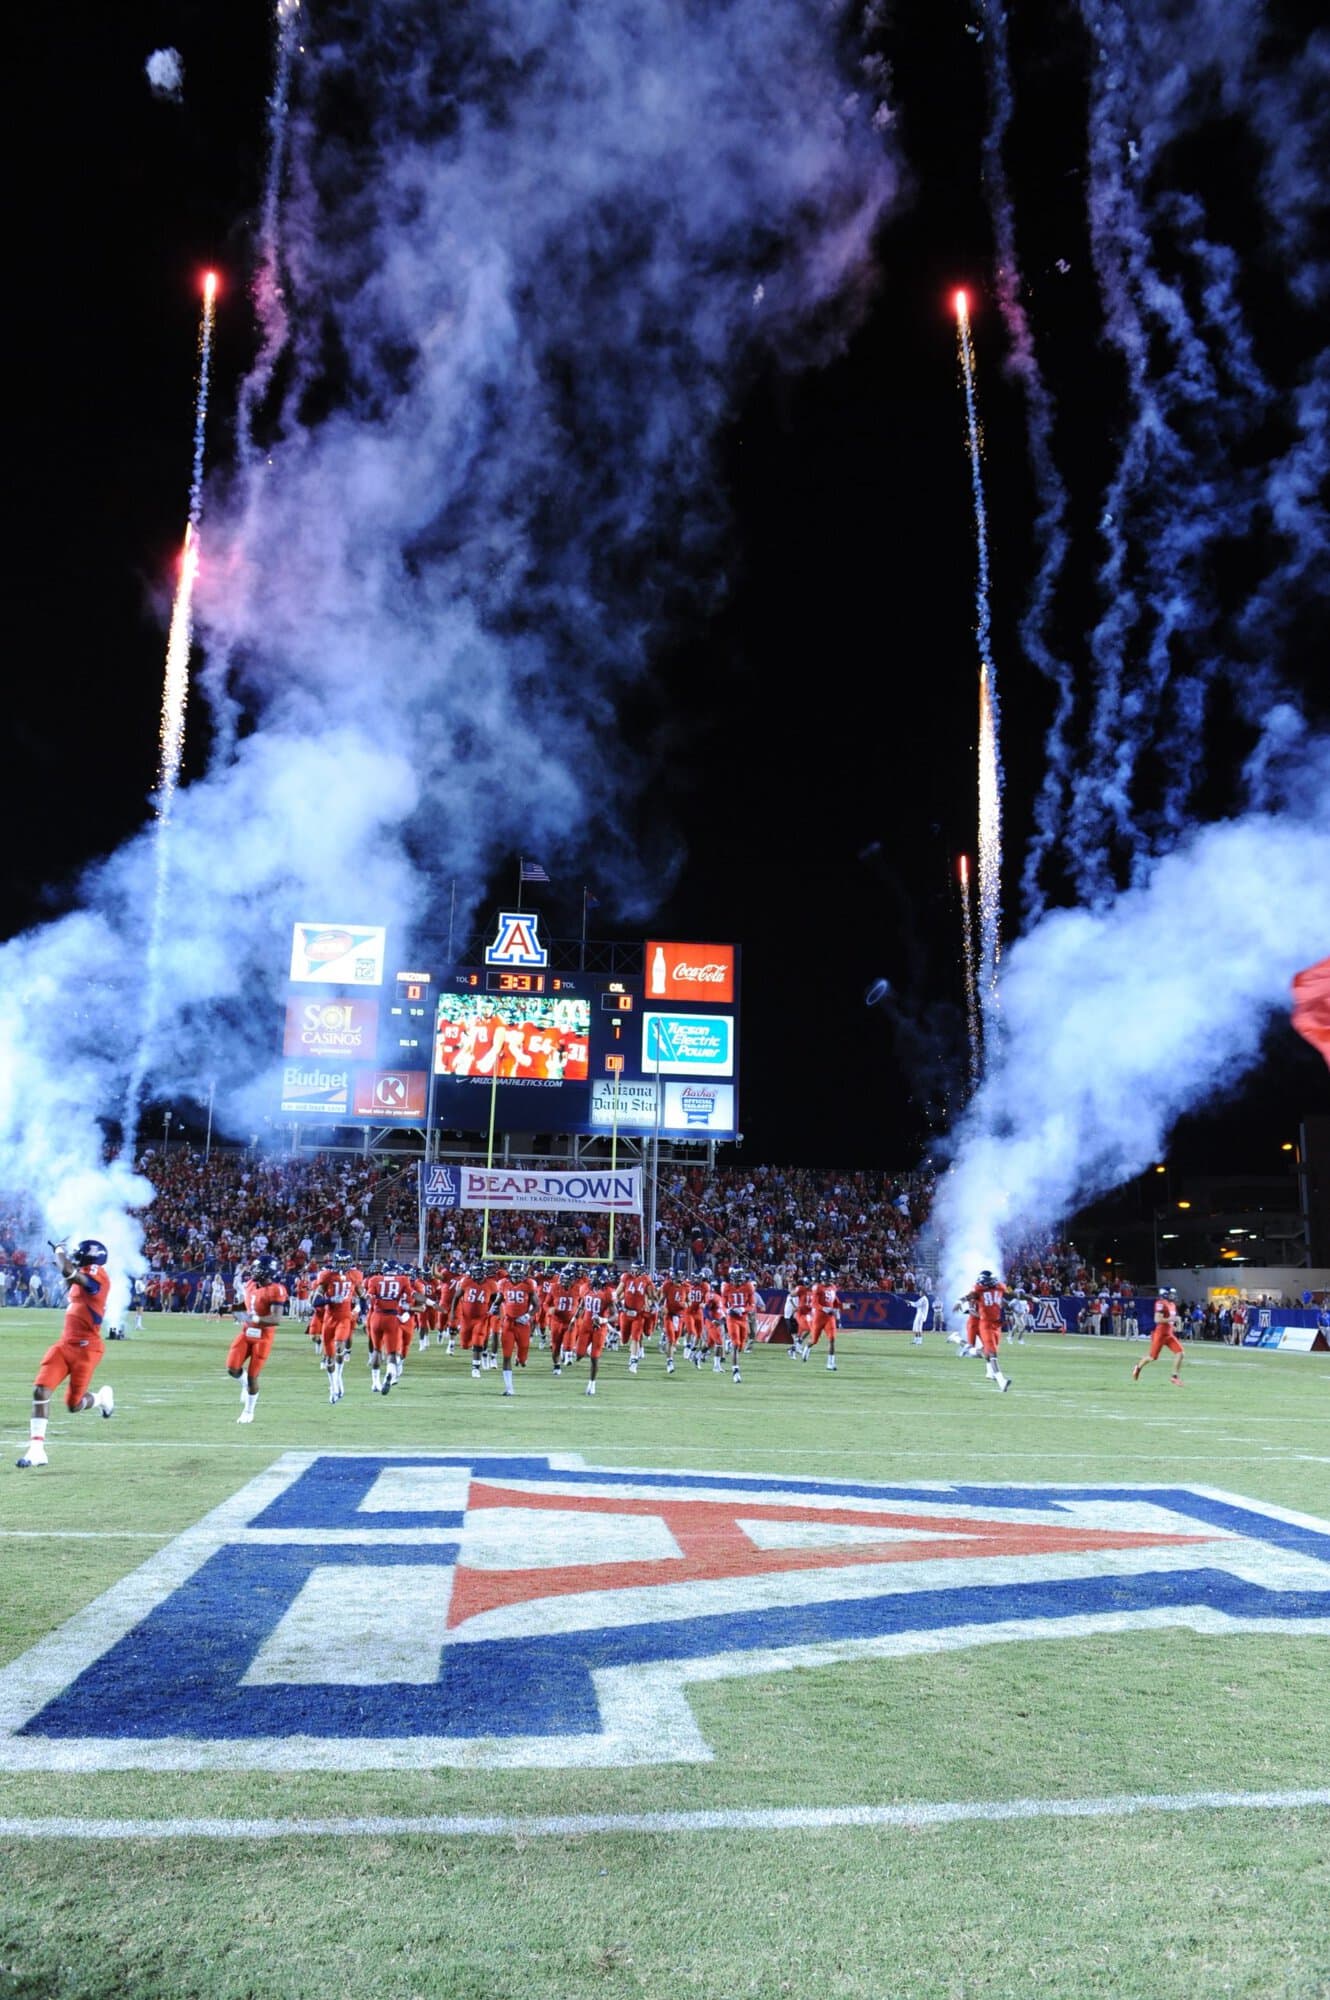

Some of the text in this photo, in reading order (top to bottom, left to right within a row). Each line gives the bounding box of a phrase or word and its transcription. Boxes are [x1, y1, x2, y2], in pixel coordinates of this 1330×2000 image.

[485, 912, 548, 967] A
[672, 962, 728, 983] Coca-Cola
[456, 976, 469, 984] TOL
[469, 975, 478, 986] 3
[500, 974, 543, 991] 3:31
[553, 979, 561, 990] 3
[562, 981, 575, 989] TOL
[619, 996, 632, 1010] 0
[303, 1004, 362, 1033] SOL
[668, 1022, 710, 1035] Tucson
[302, 1032, 362, 1046] CASINOS
[671, 1034, 721, 1047] Electric
[677, 1045, 720, 1058] Power
[284, 1067, 348, 1089] Budget
[382, 1079, 401, 1103] K
[545, 1177, 634, 1199] DOWN
[426, 1196, 455, 1206] CLUB
[377, 1280, 400, 1299] 18
[506, 1289, 525, 1304] 26
[628, 1283, 645, 1296] 44
[558, 1296, 573, 1312] 61
[732, 1292, 745, 1306] 11
